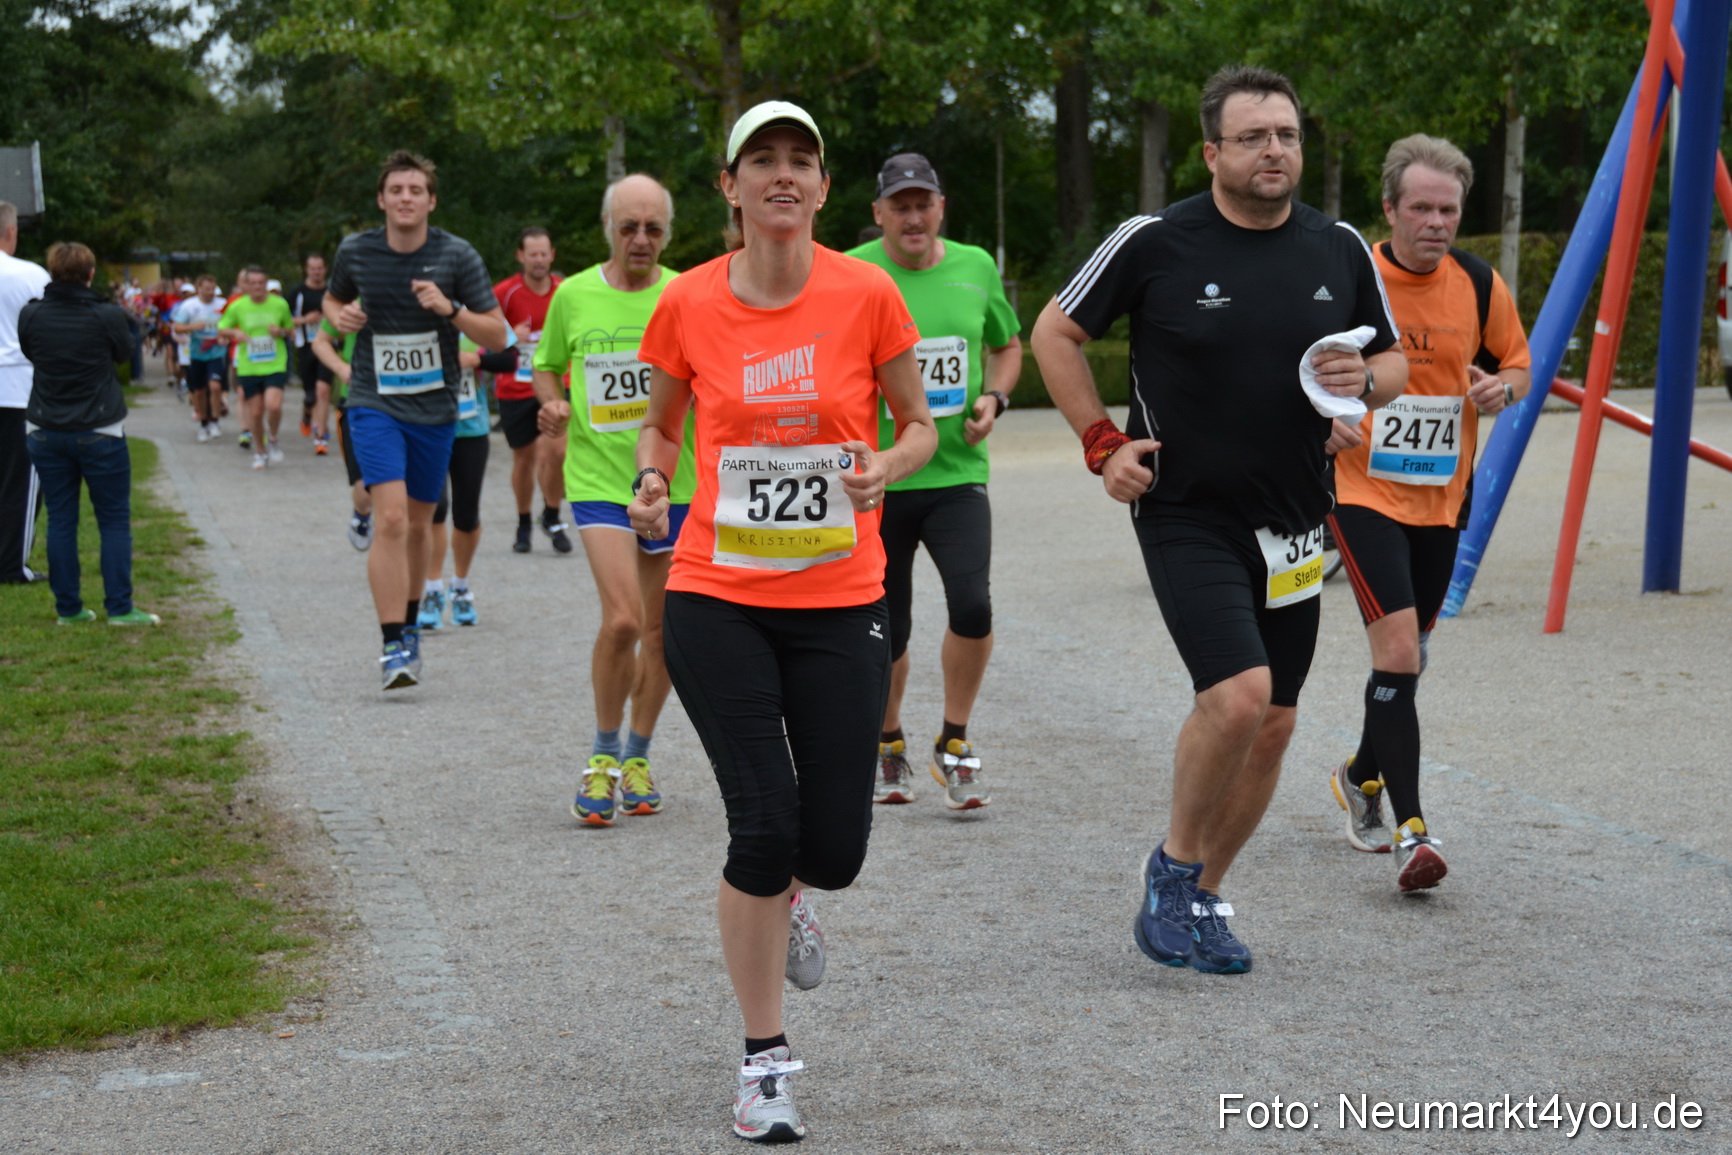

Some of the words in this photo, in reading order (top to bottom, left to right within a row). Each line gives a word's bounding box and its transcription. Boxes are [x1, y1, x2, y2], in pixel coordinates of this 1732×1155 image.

[916, 344, 955, 353] Neumarkt
[382, 347, 435, 371] 2601
[585, 361, 611, 369] PARTL
[743, 344, 815, 396] RUNWAY
[917, 356, 961, 385] 743
[601, 367, 652, 401] 296
[800, 379, 815, 391] RUN
[777, 405, 805, 413] 130928
[1411, 404, 1452, 414] Neumarkt
[1382, 416, 1454, 450] 2474
[721, 459, 766, 472] PARTL
[768, 458, 834, 471] Neumarkt
[1402, 458, 1436, 473] Franz
[747, 475, 829, 523] 523
[737, 532, 821, 546] KRISZTINA
[1283, 527, 1322, 565] 324
[1294, 565, 1321, 587] Stefan
